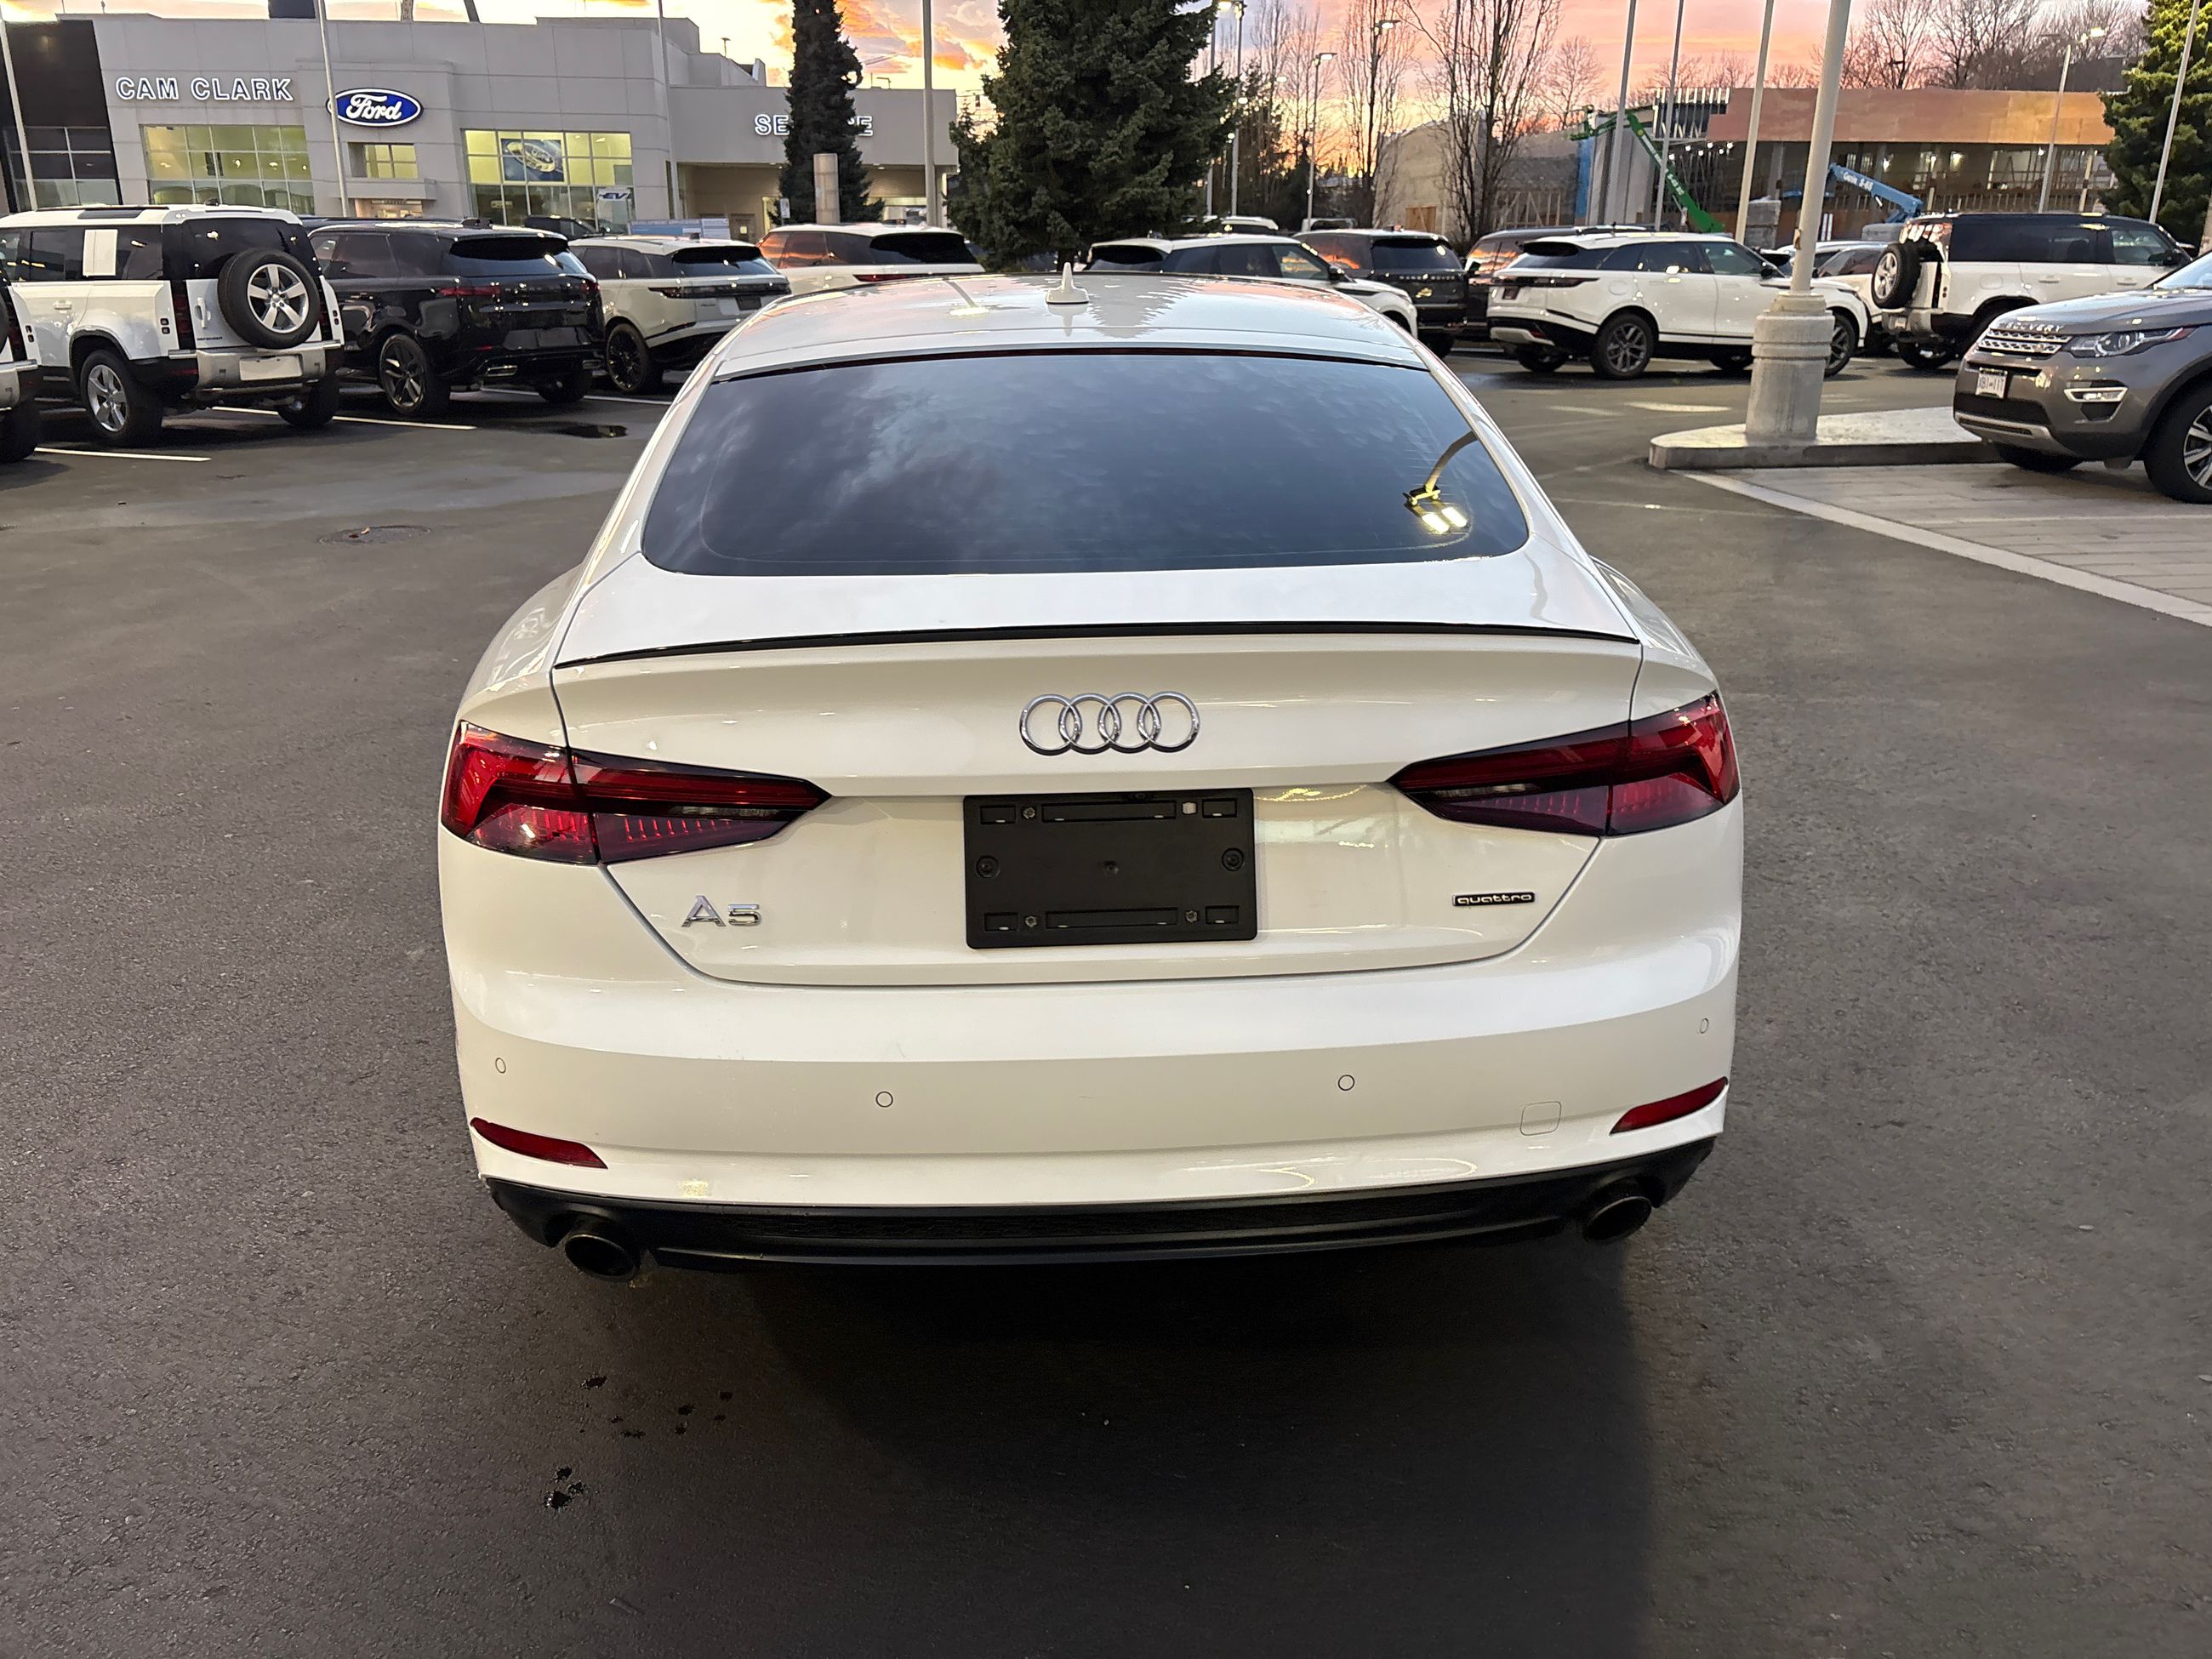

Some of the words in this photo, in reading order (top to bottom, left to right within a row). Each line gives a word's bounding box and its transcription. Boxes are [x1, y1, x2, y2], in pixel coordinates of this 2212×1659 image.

[116, 77, 179, 100] CAM
[191, 77, 294, 101] CLARK
[345, 94, 402, 120] Ford
[681, 895, 761, 927] A5
[1457, 893, 1532, 905] quattro
